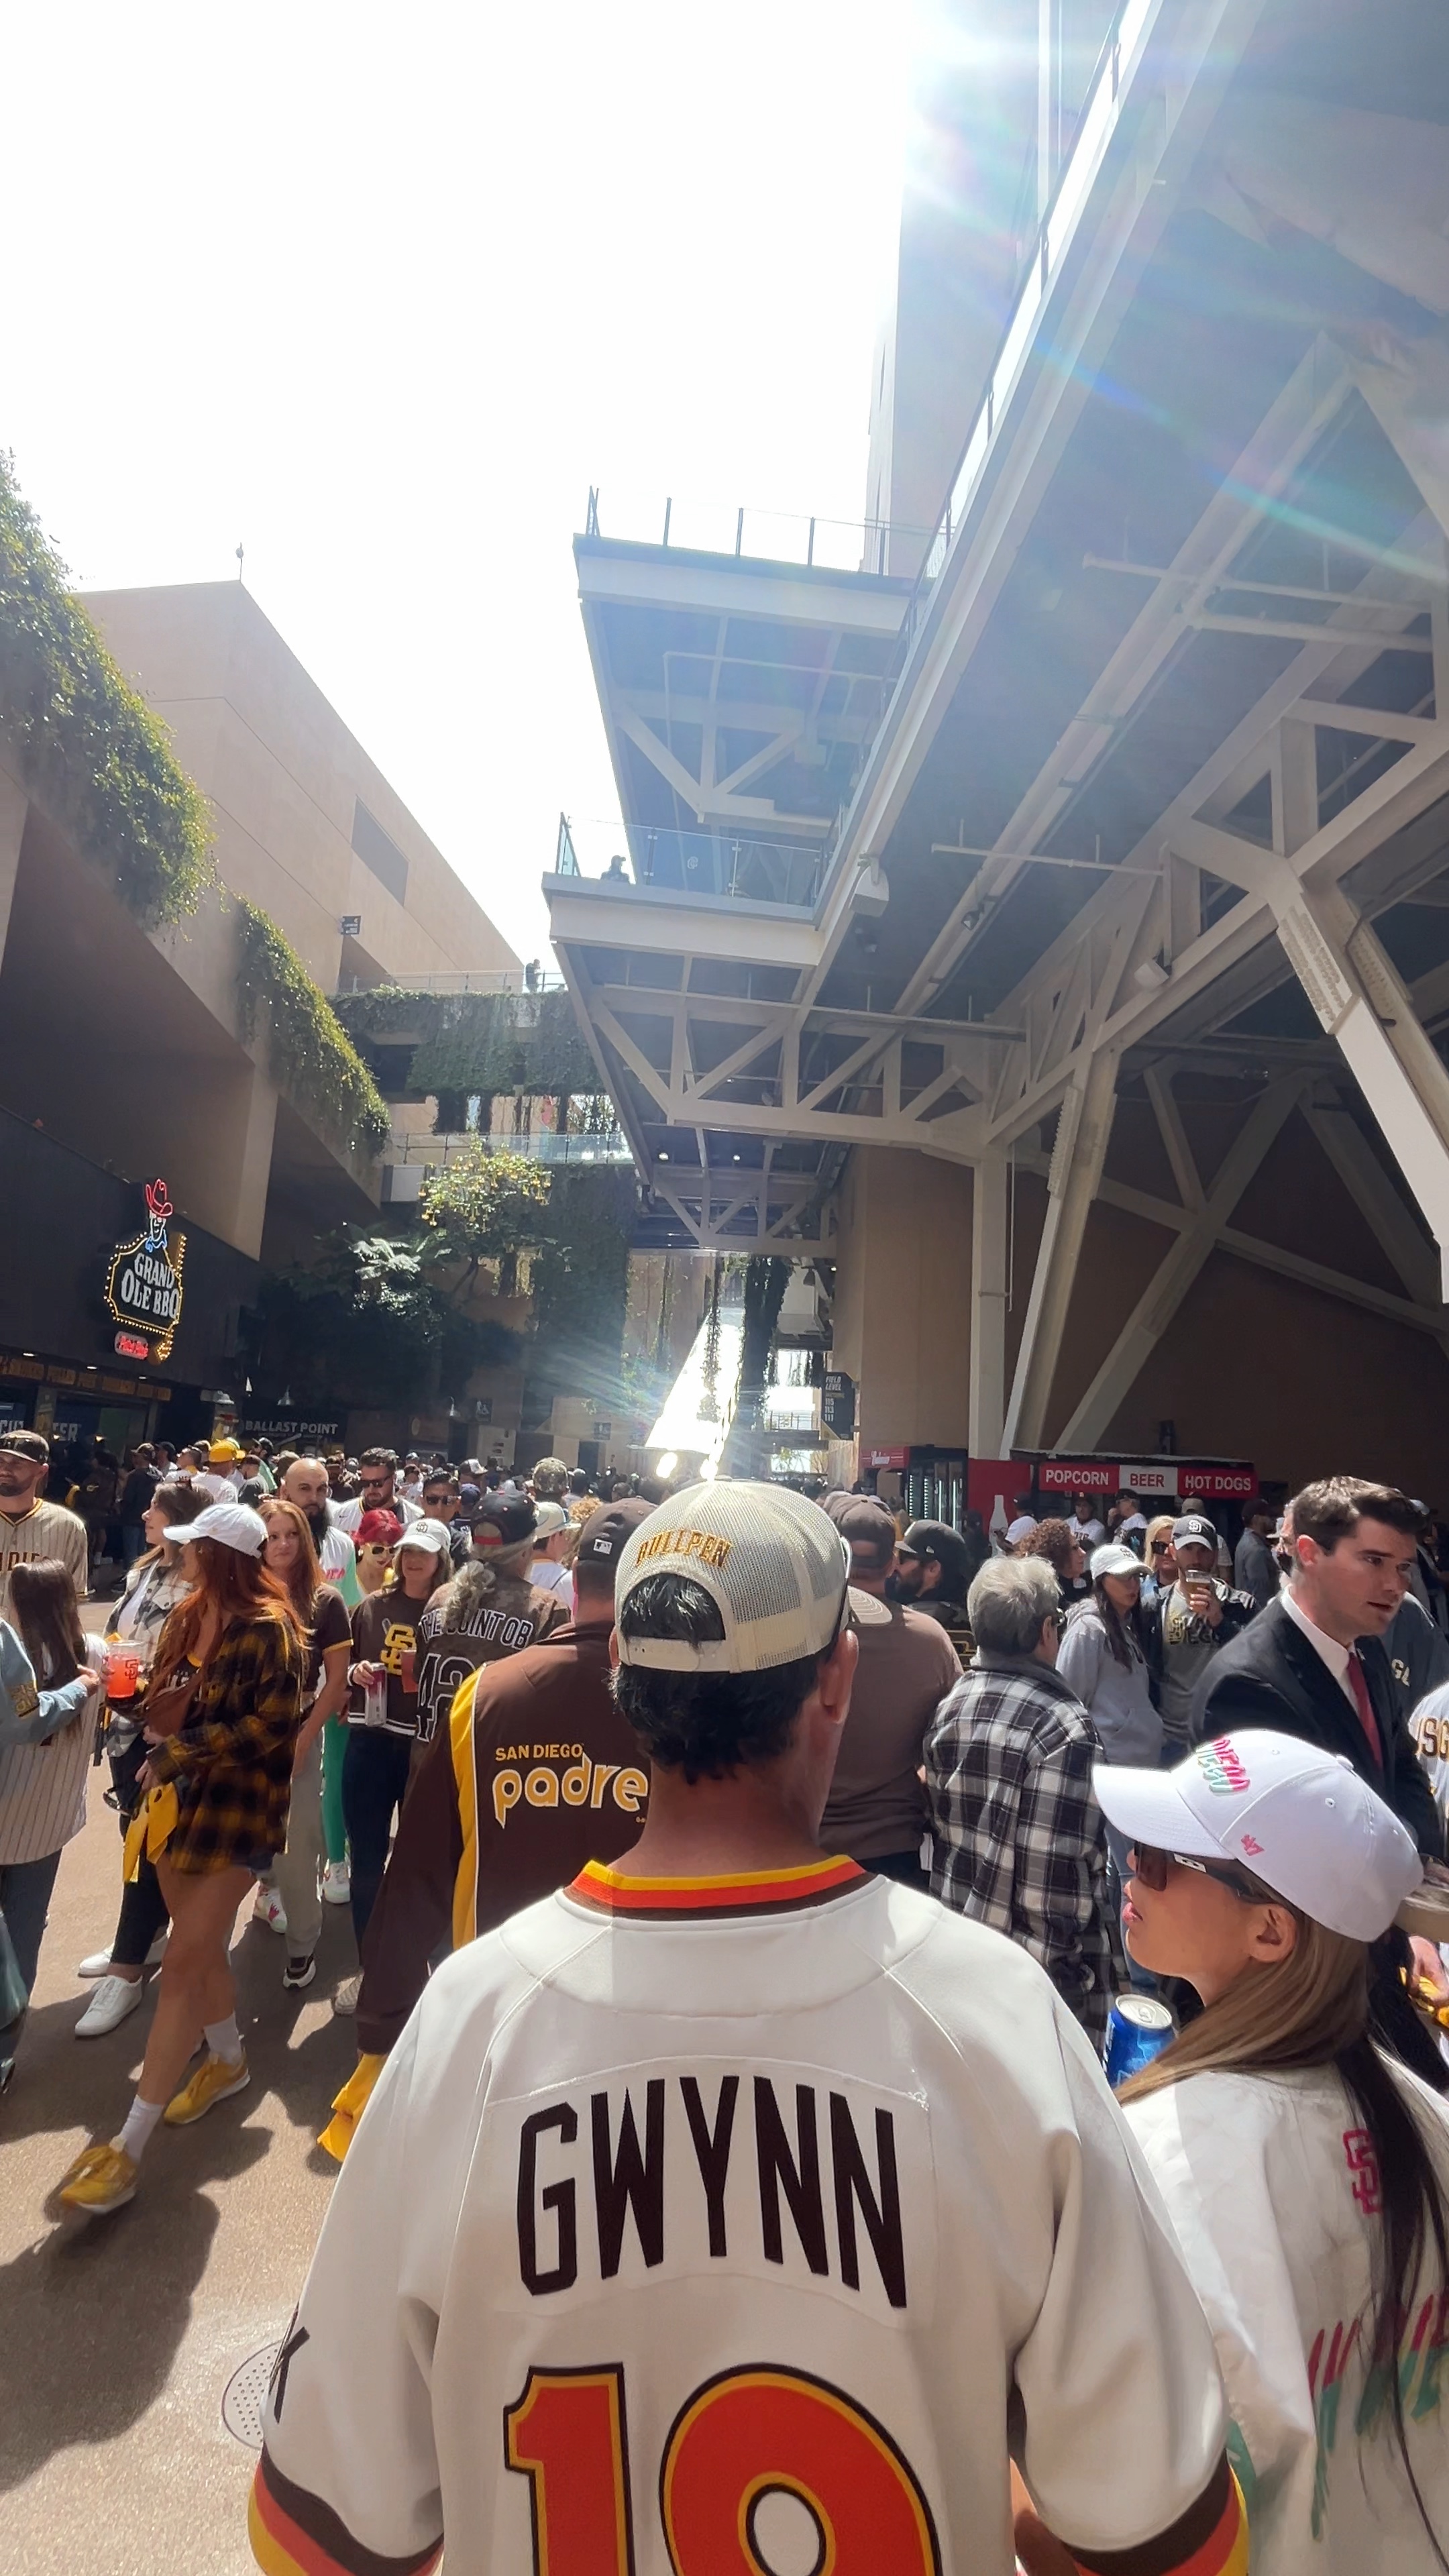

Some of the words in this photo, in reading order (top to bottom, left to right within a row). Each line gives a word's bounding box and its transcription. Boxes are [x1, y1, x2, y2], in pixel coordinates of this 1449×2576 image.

[134, 1252, 174, 1289] GRAND
[152, 1289, 180, 1322] BBQ
[824, 1413, 834, 1421] 111
[246, 1420, 297, 1433] BALLAST
[300, 1422, 338, 1434] POINT
[1045, 1469, 1109, 1485] POPCORN
[1130, 1473, 1165, 1487] BEER
[1185, 1474, 1211, 1489] HOT
[1215, 1476, 1252, 1491] DOGS
[419, 1608, 445, 1643] THE
[447, 1609, 506, 1642] OINT
[495, 1746, 529, 1762] SAN
[533, 1744, 583, 1758] DIEGO
[517, 2075, 907, 2308] GWYNN
